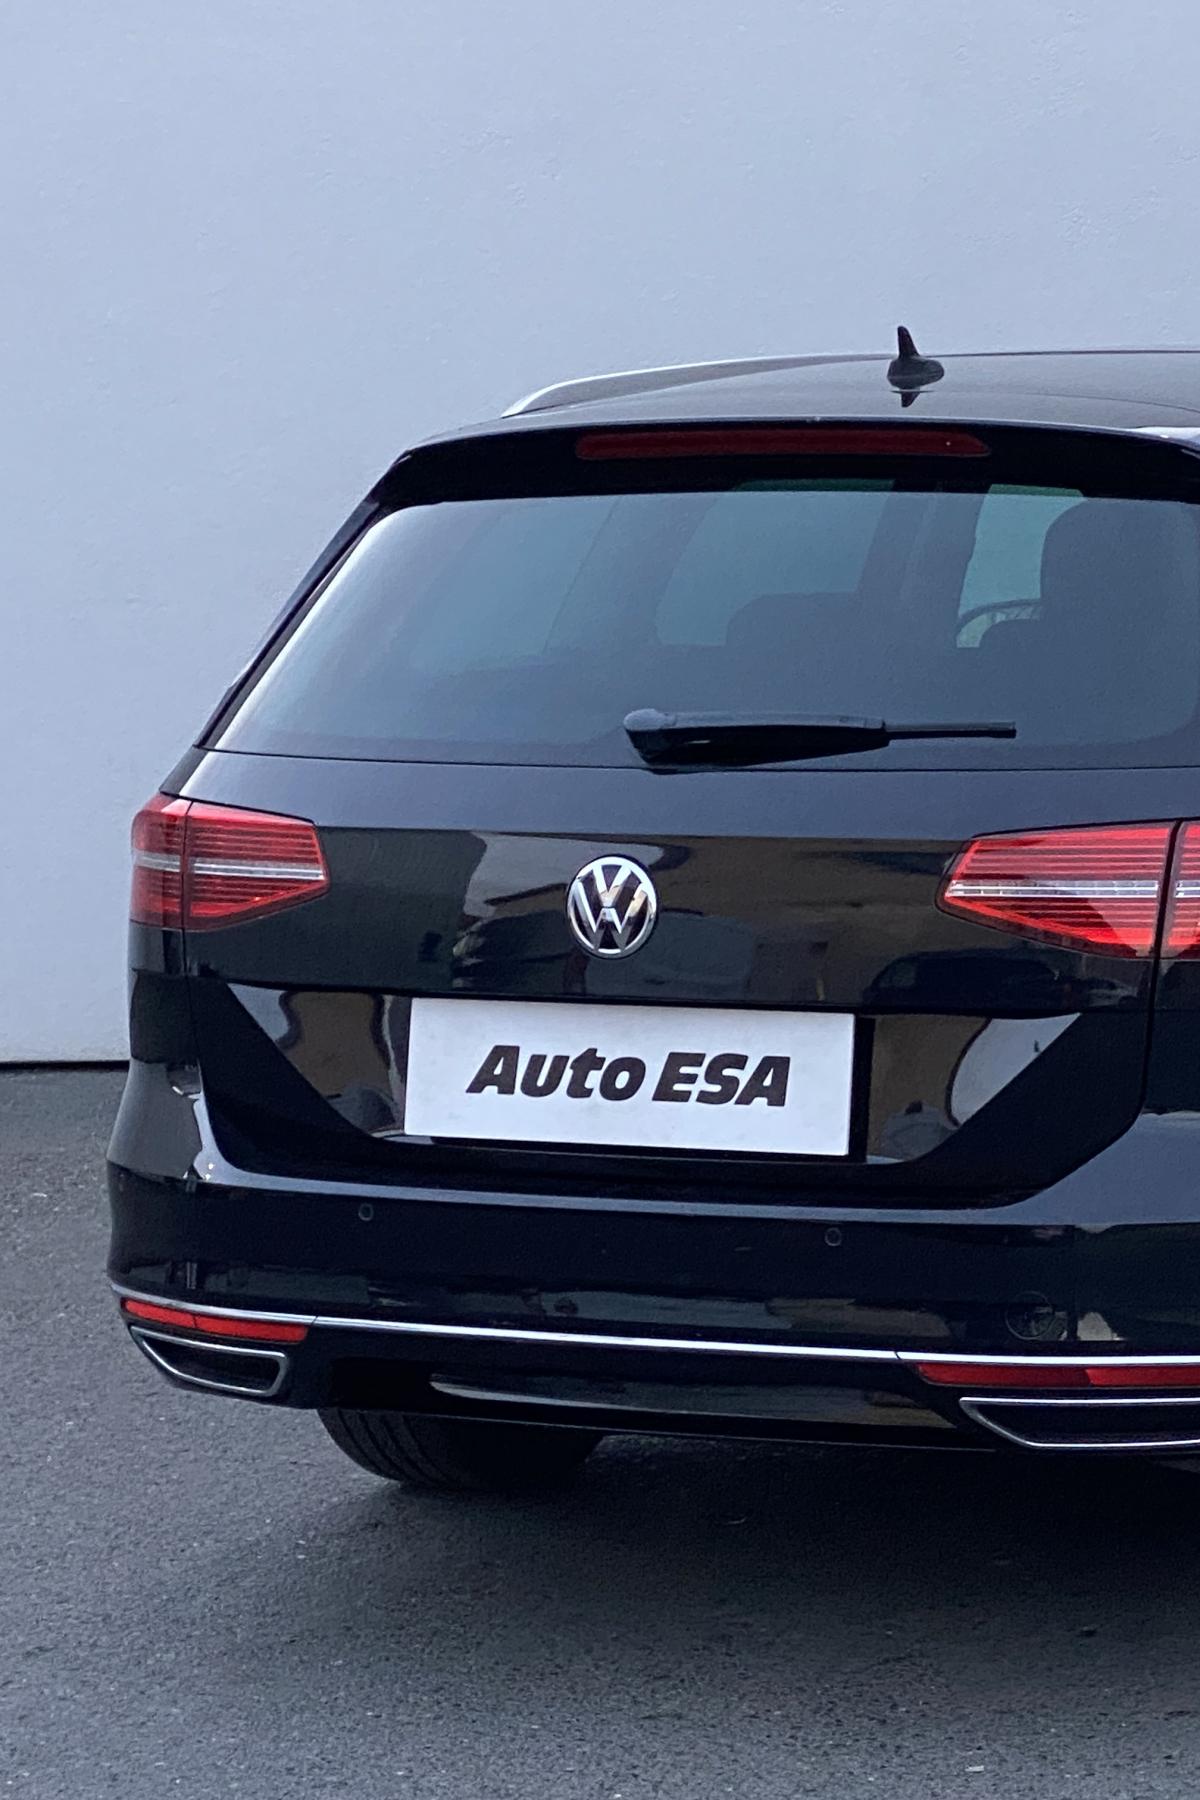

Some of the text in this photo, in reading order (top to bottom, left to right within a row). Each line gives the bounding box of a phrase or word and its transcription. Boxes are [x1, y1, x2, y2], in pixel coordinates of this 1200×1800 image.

[568, 855, 657, 957] VW
[465, 1045, 791, 1107] Auto ESA
